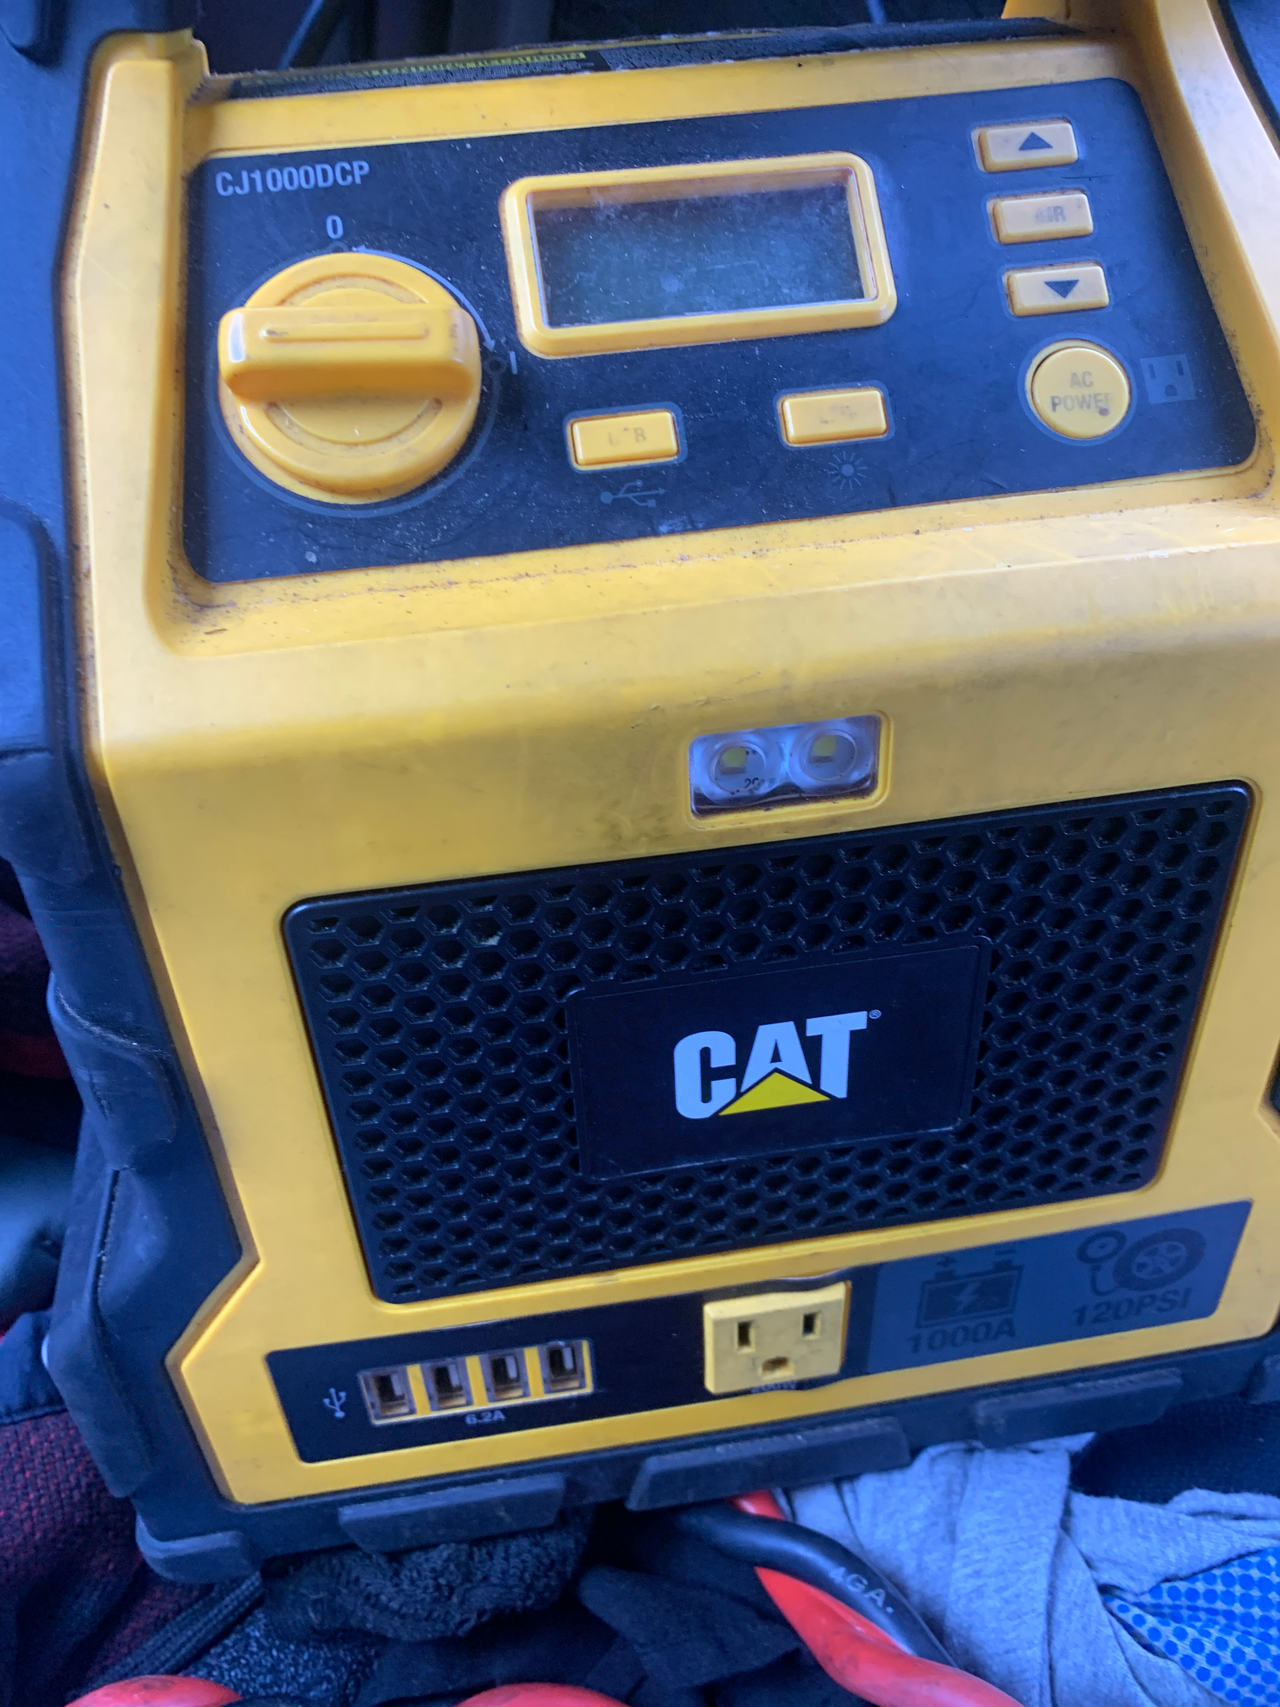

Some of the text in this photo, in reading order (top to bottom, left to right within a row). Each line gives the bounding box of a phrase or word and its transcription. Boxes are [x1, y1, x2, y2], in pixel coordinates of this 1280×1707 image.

[215, 160, 370, 196] CJ1000DCP
[1069, 371, 1094, 388] AC
[673, 1011, 868, 1120] CAT
[1073, 1287, 1192, 1327] 120PSI
[907, 1317, 1016, 1353] 1000A
[465, 1409, 506, 1425] 6.2A
